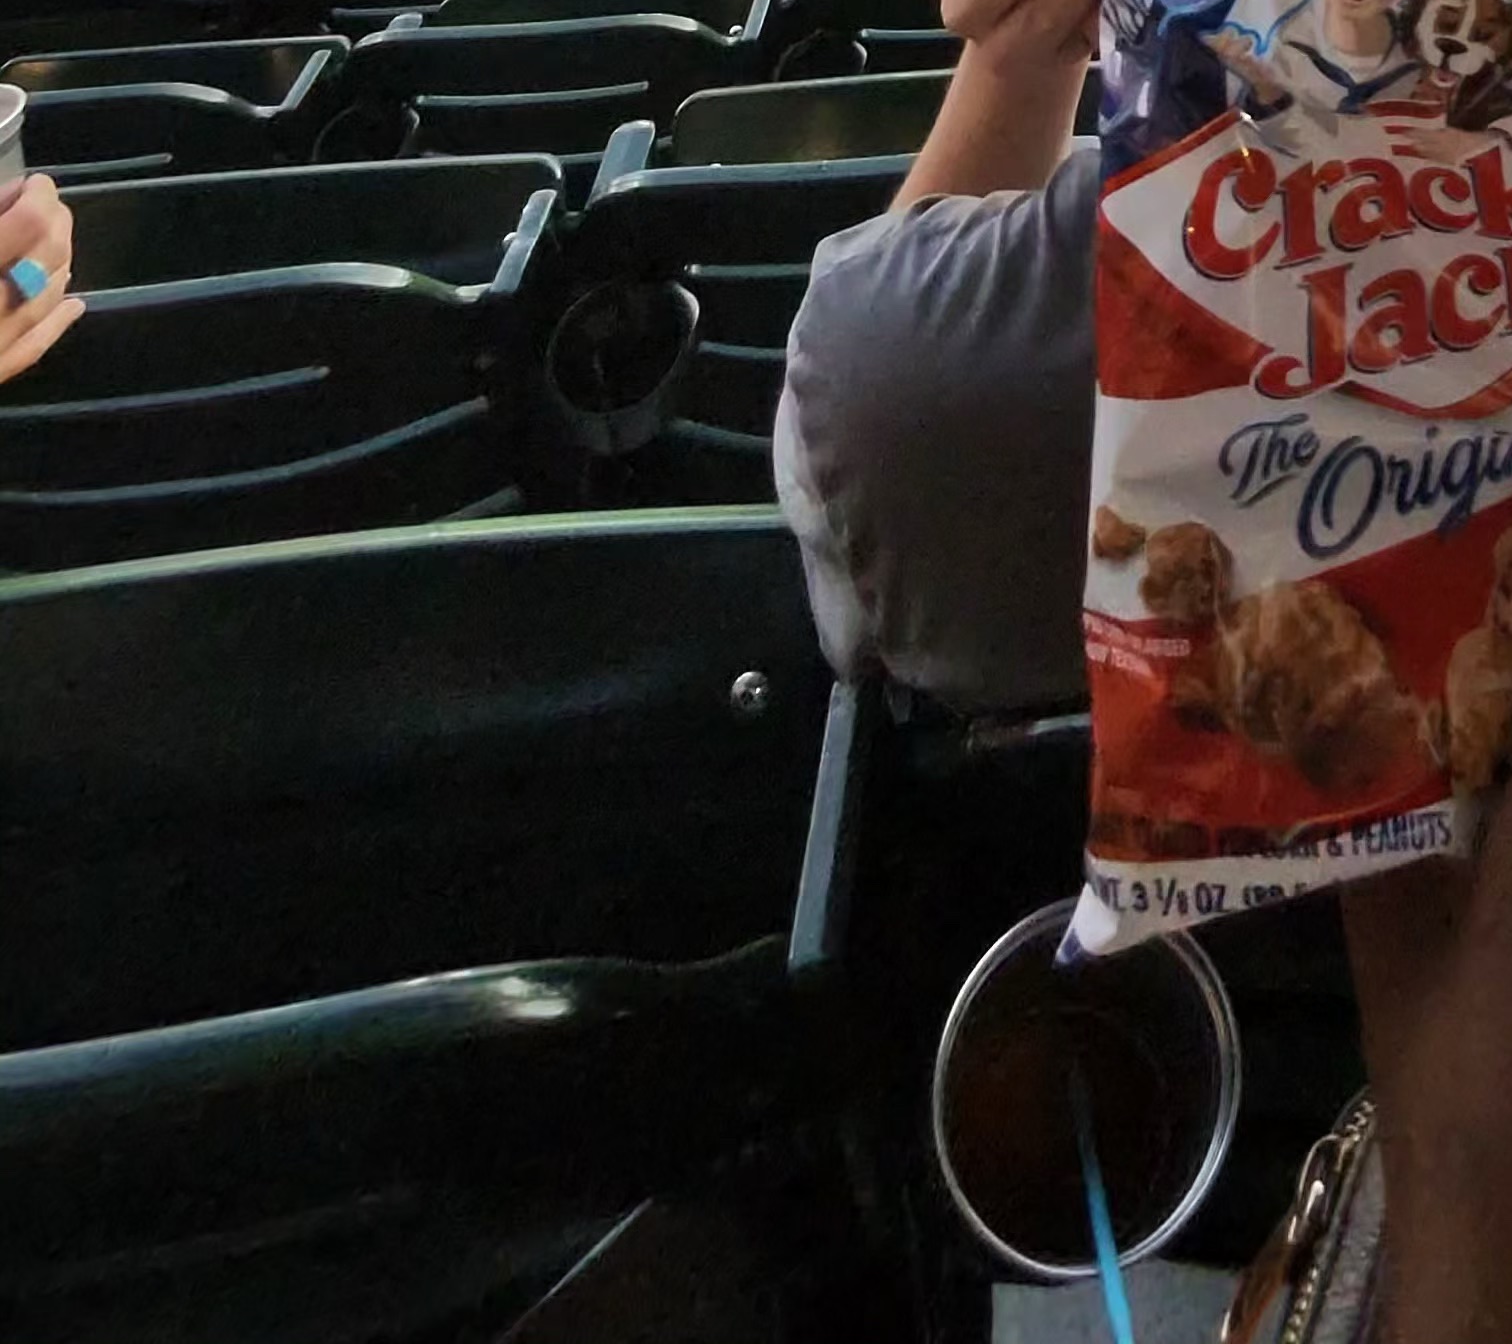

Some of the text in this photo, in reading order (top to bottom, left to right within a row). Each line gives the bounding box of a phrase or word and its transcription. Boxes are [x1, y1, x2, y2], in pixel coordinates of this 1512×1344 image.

[1218, 413, 1320, 508] The
[1352, 810, 1453, 856] PEANUTS
[1131, 881, 1150, 912] 3
[1194, 882, 1227, 914] OZ
